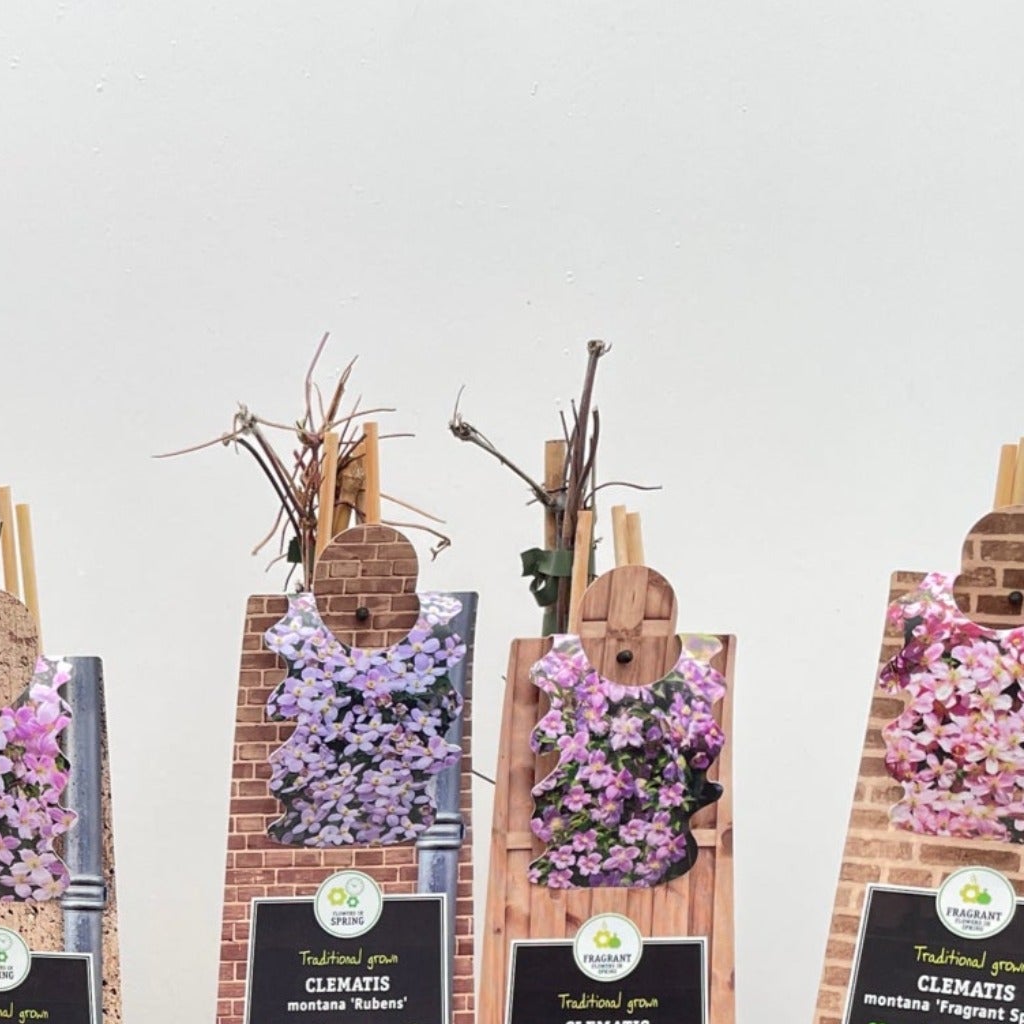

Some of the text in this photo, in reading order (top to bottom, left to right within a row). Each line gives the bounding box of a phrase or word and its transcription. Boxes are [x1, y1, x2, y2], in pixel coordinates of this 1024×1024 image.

[331, 916, 364, 926] SPRING
[946, 906, 1003, 921] FRAGRANT
[299, 948, 399, 970] Traditional grown
[583, 954, 632, 963] FRAGRANT
[914, 945, 987, 969] Traditional
[305, 976, 390, 993] CLEMATIS
[917, 975, 1016, 1002] CLEMATIS
[287, 996, 408, 1012] montana 'Rubens'
[558, 991, 659, 1014] Traditional grown
[864, 993, 930, 1012] montana
[936, 999, 1005, 1021] 'Fragrant
[19, 1009, 49, 1024] grown
